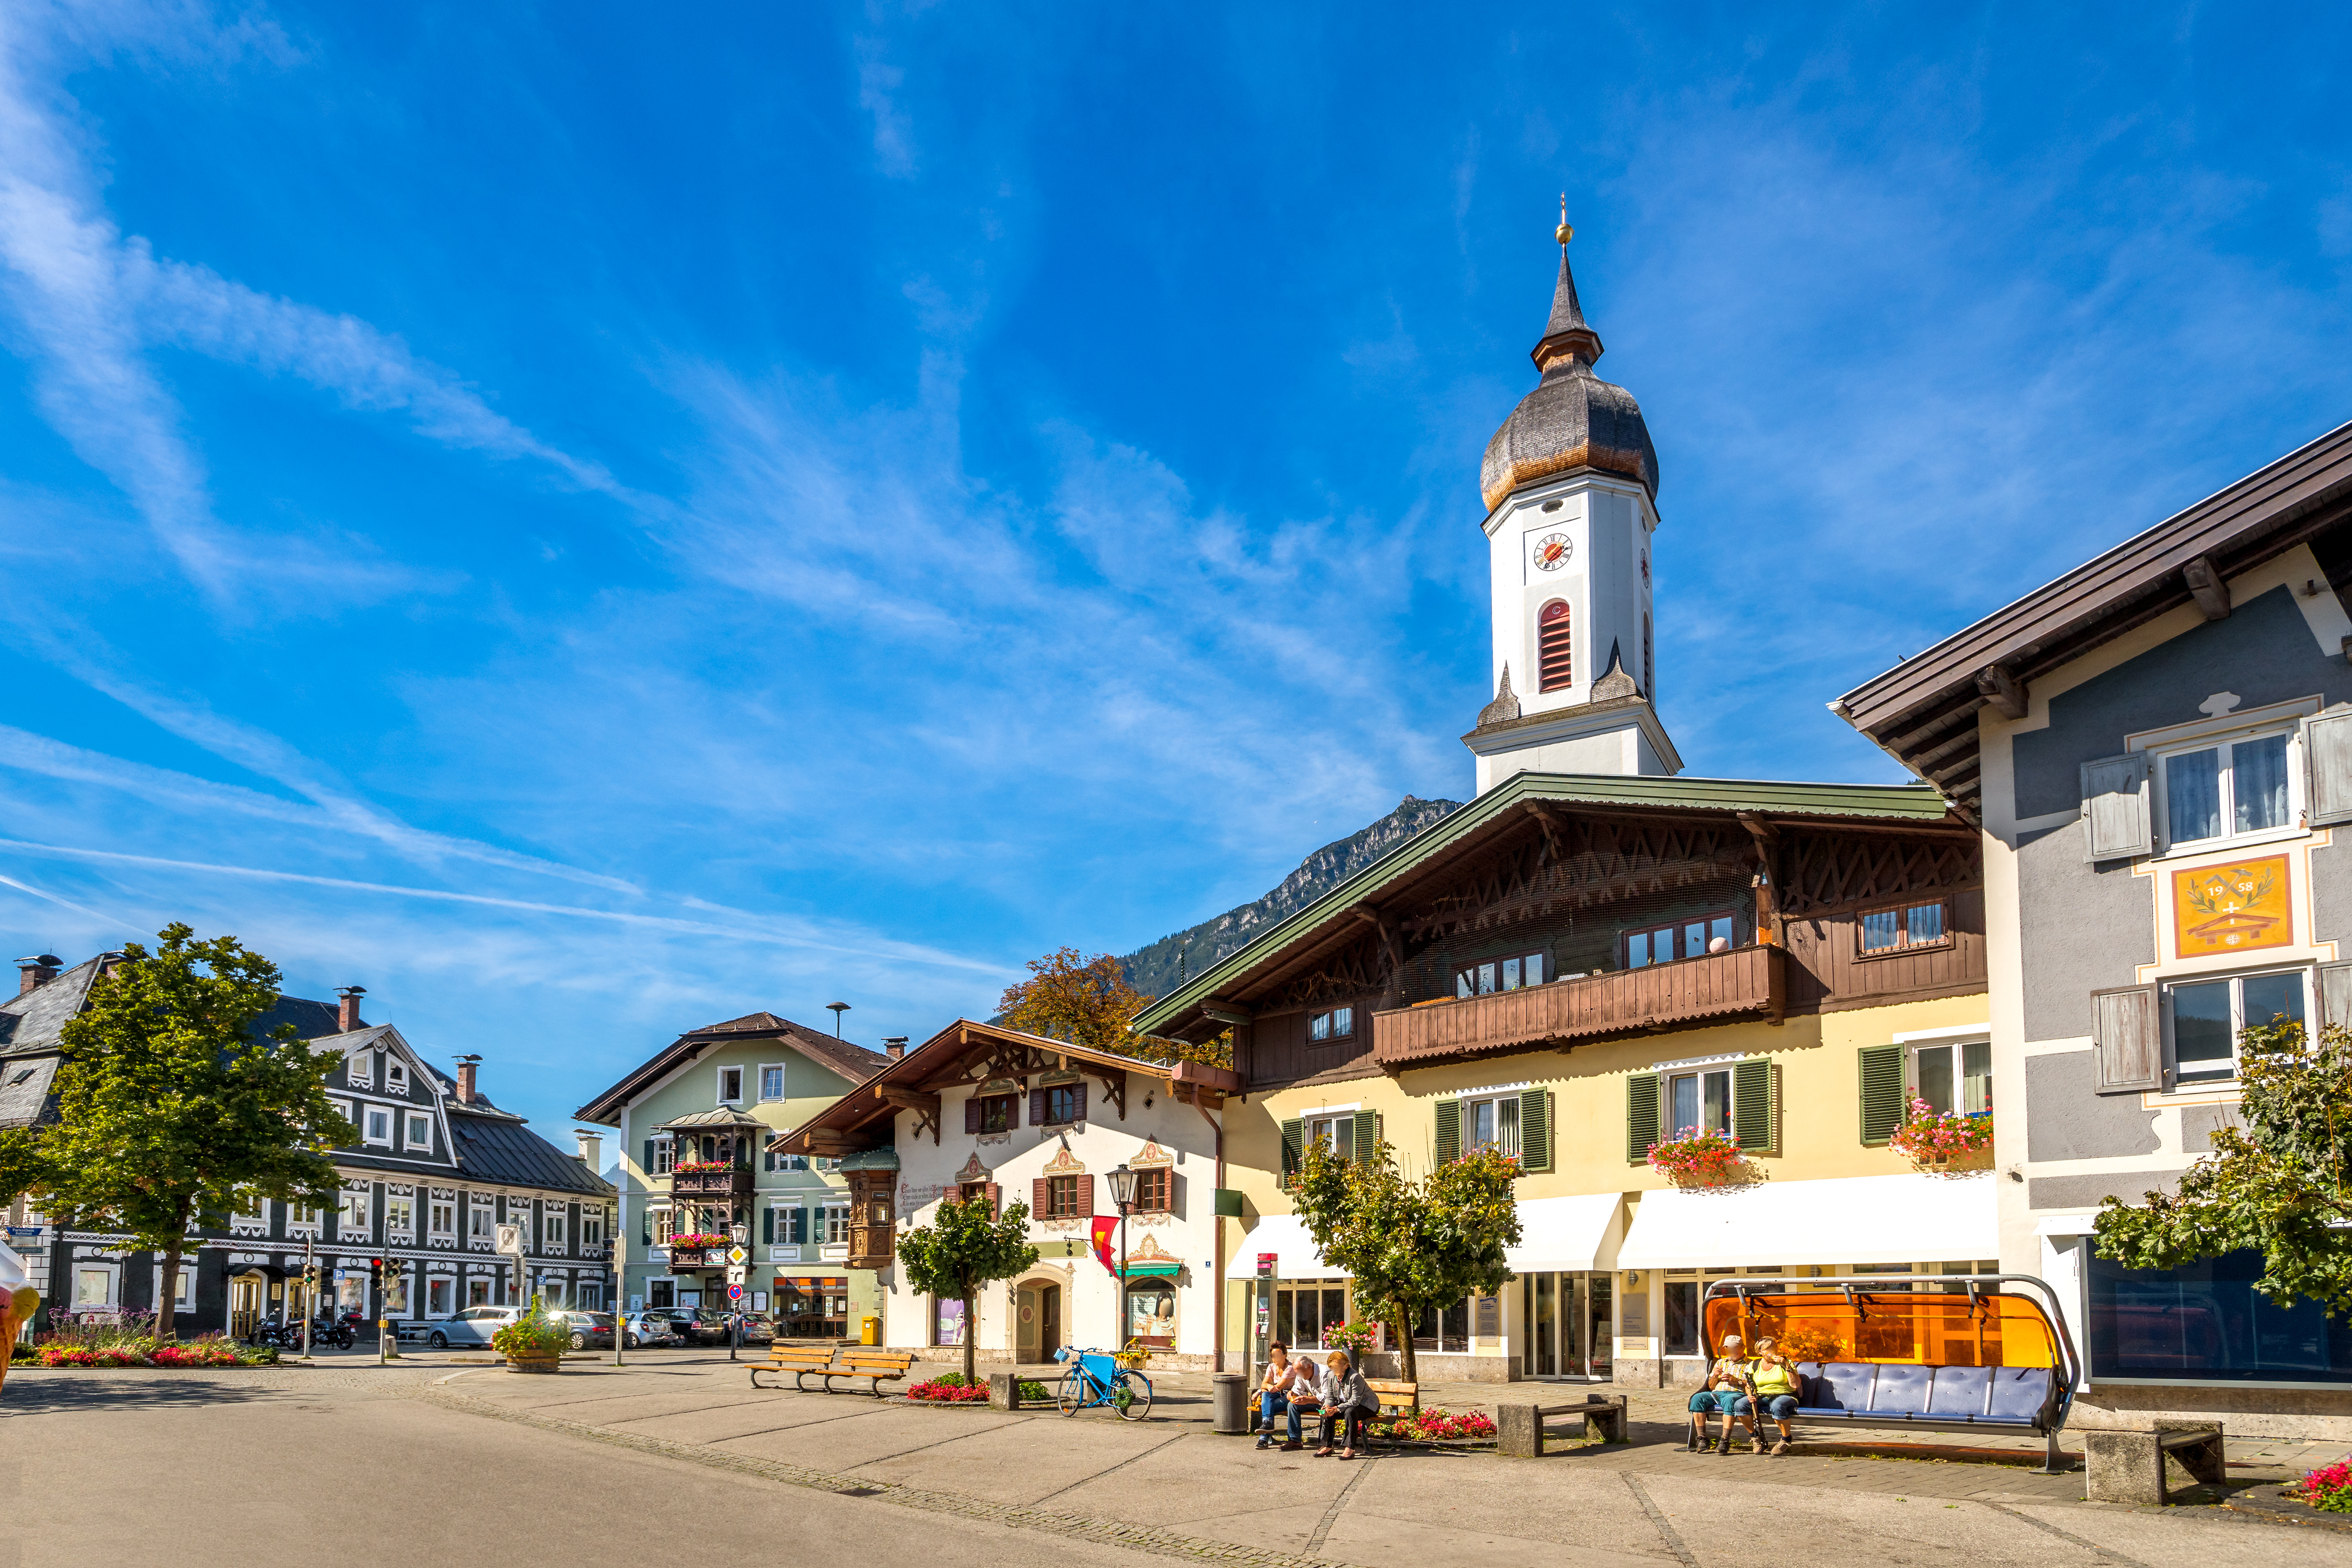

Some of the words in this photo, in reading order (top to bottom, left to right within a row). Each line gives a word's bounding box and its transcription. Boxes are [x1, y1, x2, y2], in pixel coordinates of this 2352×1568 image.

[2207, 886, 2223, 896] 19
[2238, 882, 2253, 892] 58
[336, 1271, 343, 1280] P
